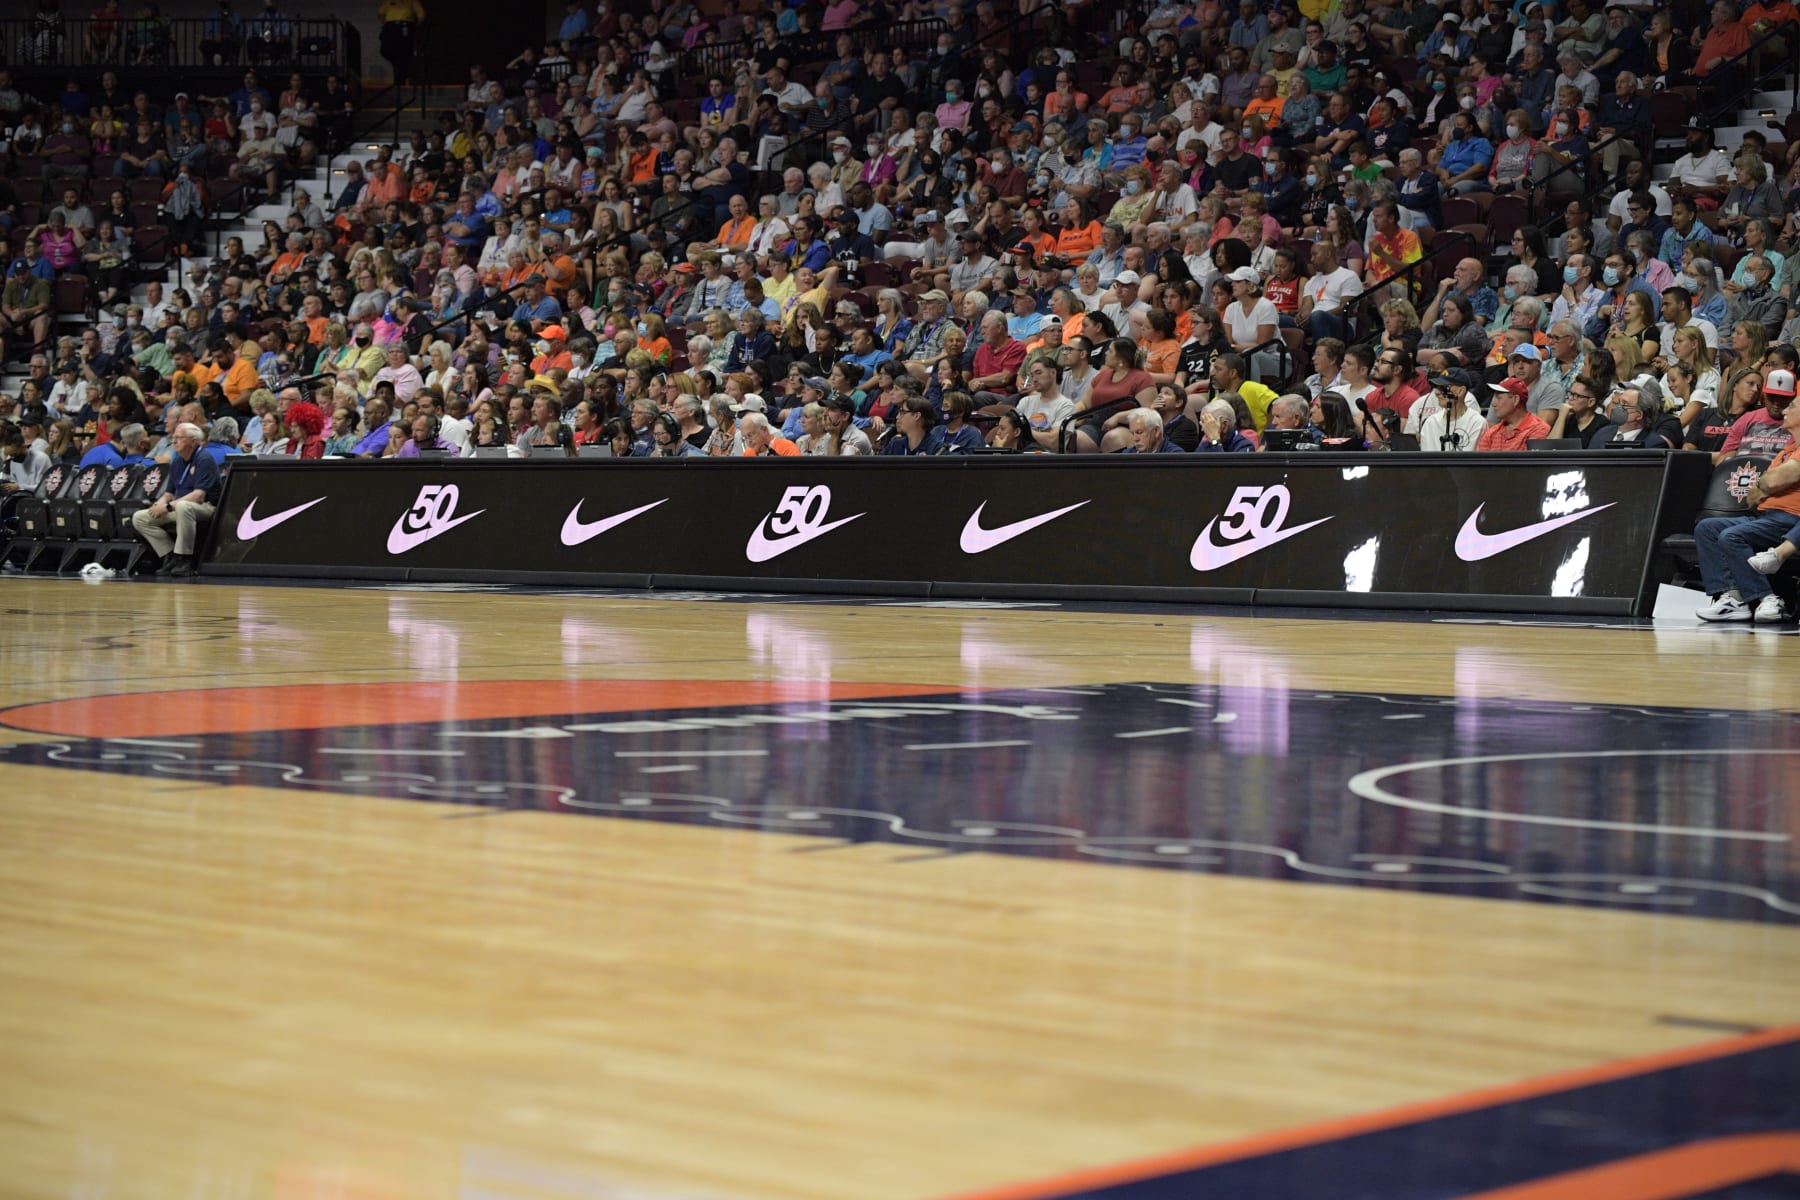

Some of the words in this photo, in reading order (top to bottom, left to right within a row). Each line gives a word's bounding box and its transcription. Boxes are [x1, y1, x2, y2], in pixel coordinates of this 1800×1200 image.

[1272, 293, 1283, 304] 21
[1187, 359, 1204, 372] 22
[409, 484, 459, 528] 50
[772, 485, 831, 534] 50
[1219, 485, 1290, 540] 50
